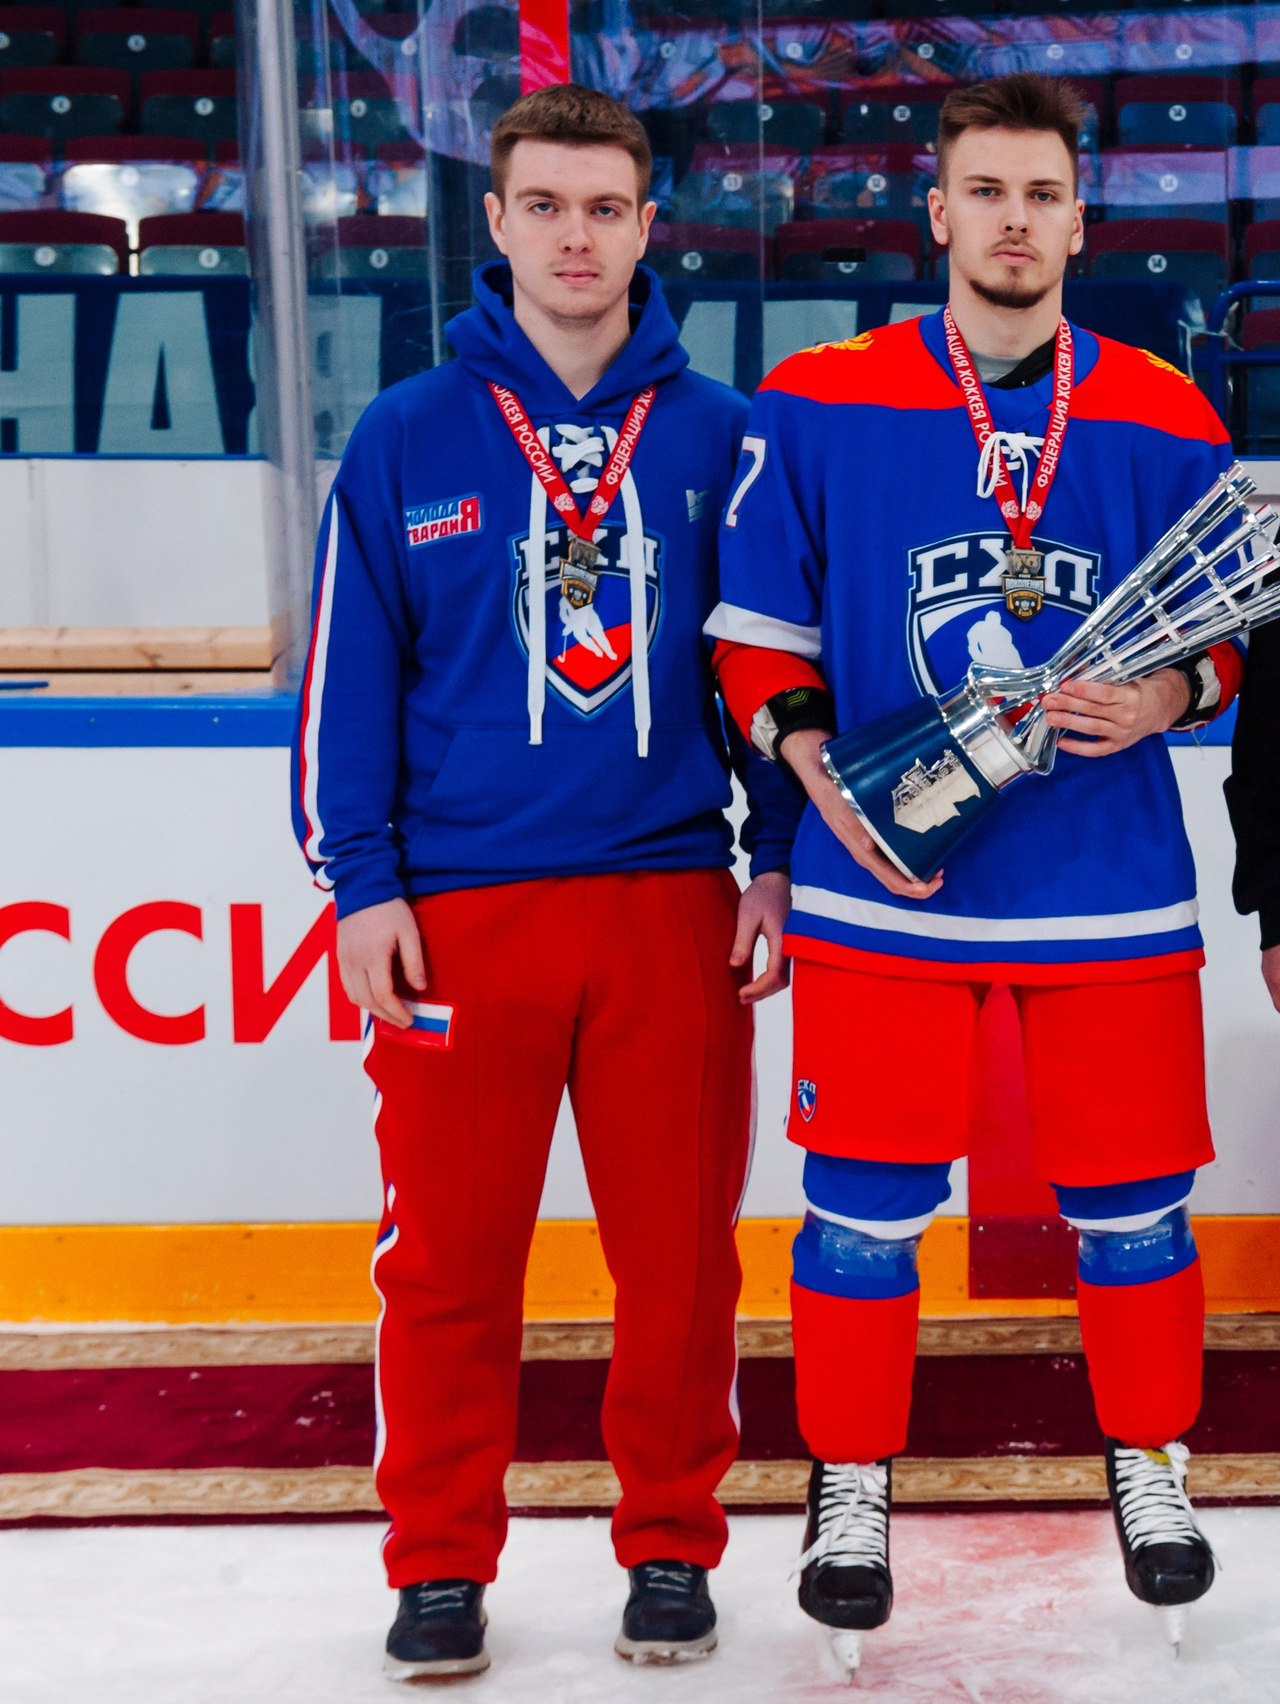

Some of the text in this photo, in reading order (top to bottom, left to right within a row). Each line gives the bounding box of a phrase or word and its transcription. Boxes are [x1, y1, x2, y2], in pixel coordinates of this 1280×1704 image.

[943, 303, 970, 368] ЕДЕРАЦИЯ
[958, 369, 987, 420] ХОККЕЯ
[1037, 317, 1072, 488] ФЕДЕРАЦИЯ ХОККЕЯ РОСС
[492, 384, 557, 484] ОККЕЯ РОССИИ
[606, 405, 647, 486] ФЕДЕРАЦИЯ
[725, 436, 766, 528] 7
